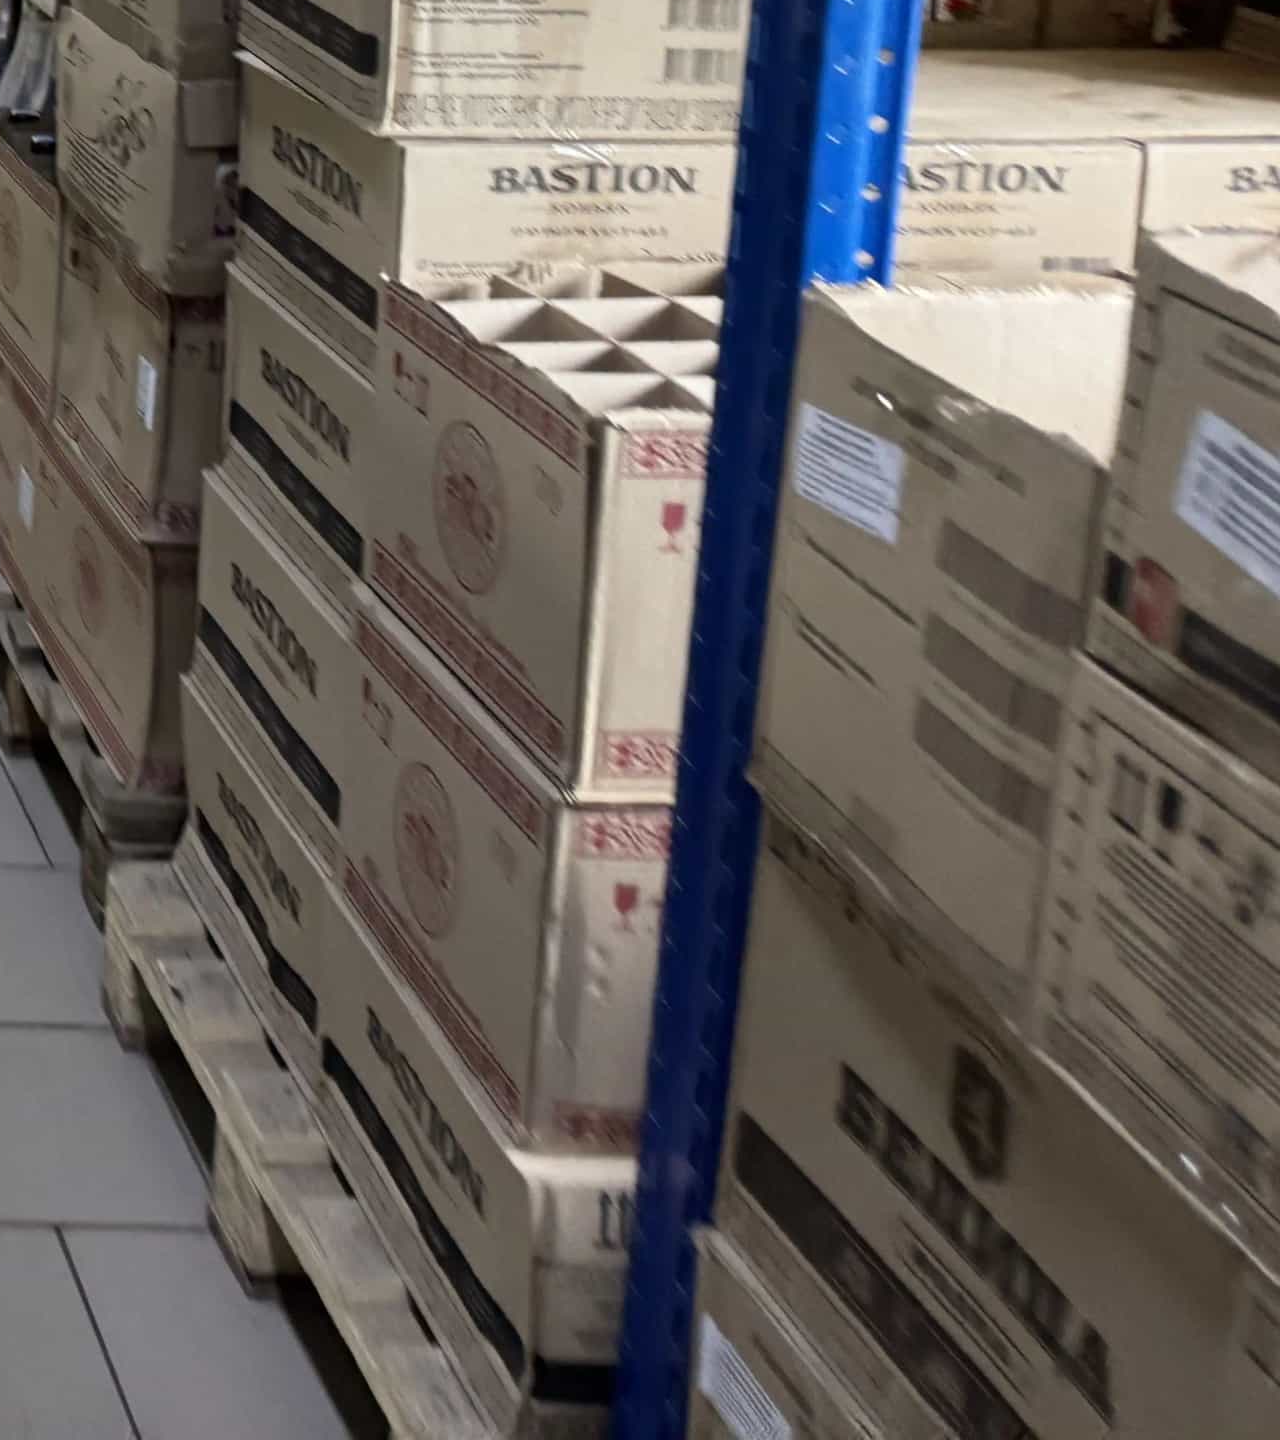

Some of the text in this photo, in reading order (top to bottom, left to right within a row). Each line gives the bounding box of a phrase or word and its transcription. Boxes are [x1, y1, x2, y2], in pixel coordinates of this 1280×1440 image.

[270, 124, 363, 221] BASTION
[487, 163, 701, 195] BASTION
[899, 161, 1071, 194] ASTION
[259, 346, 352, 463] BASTION
